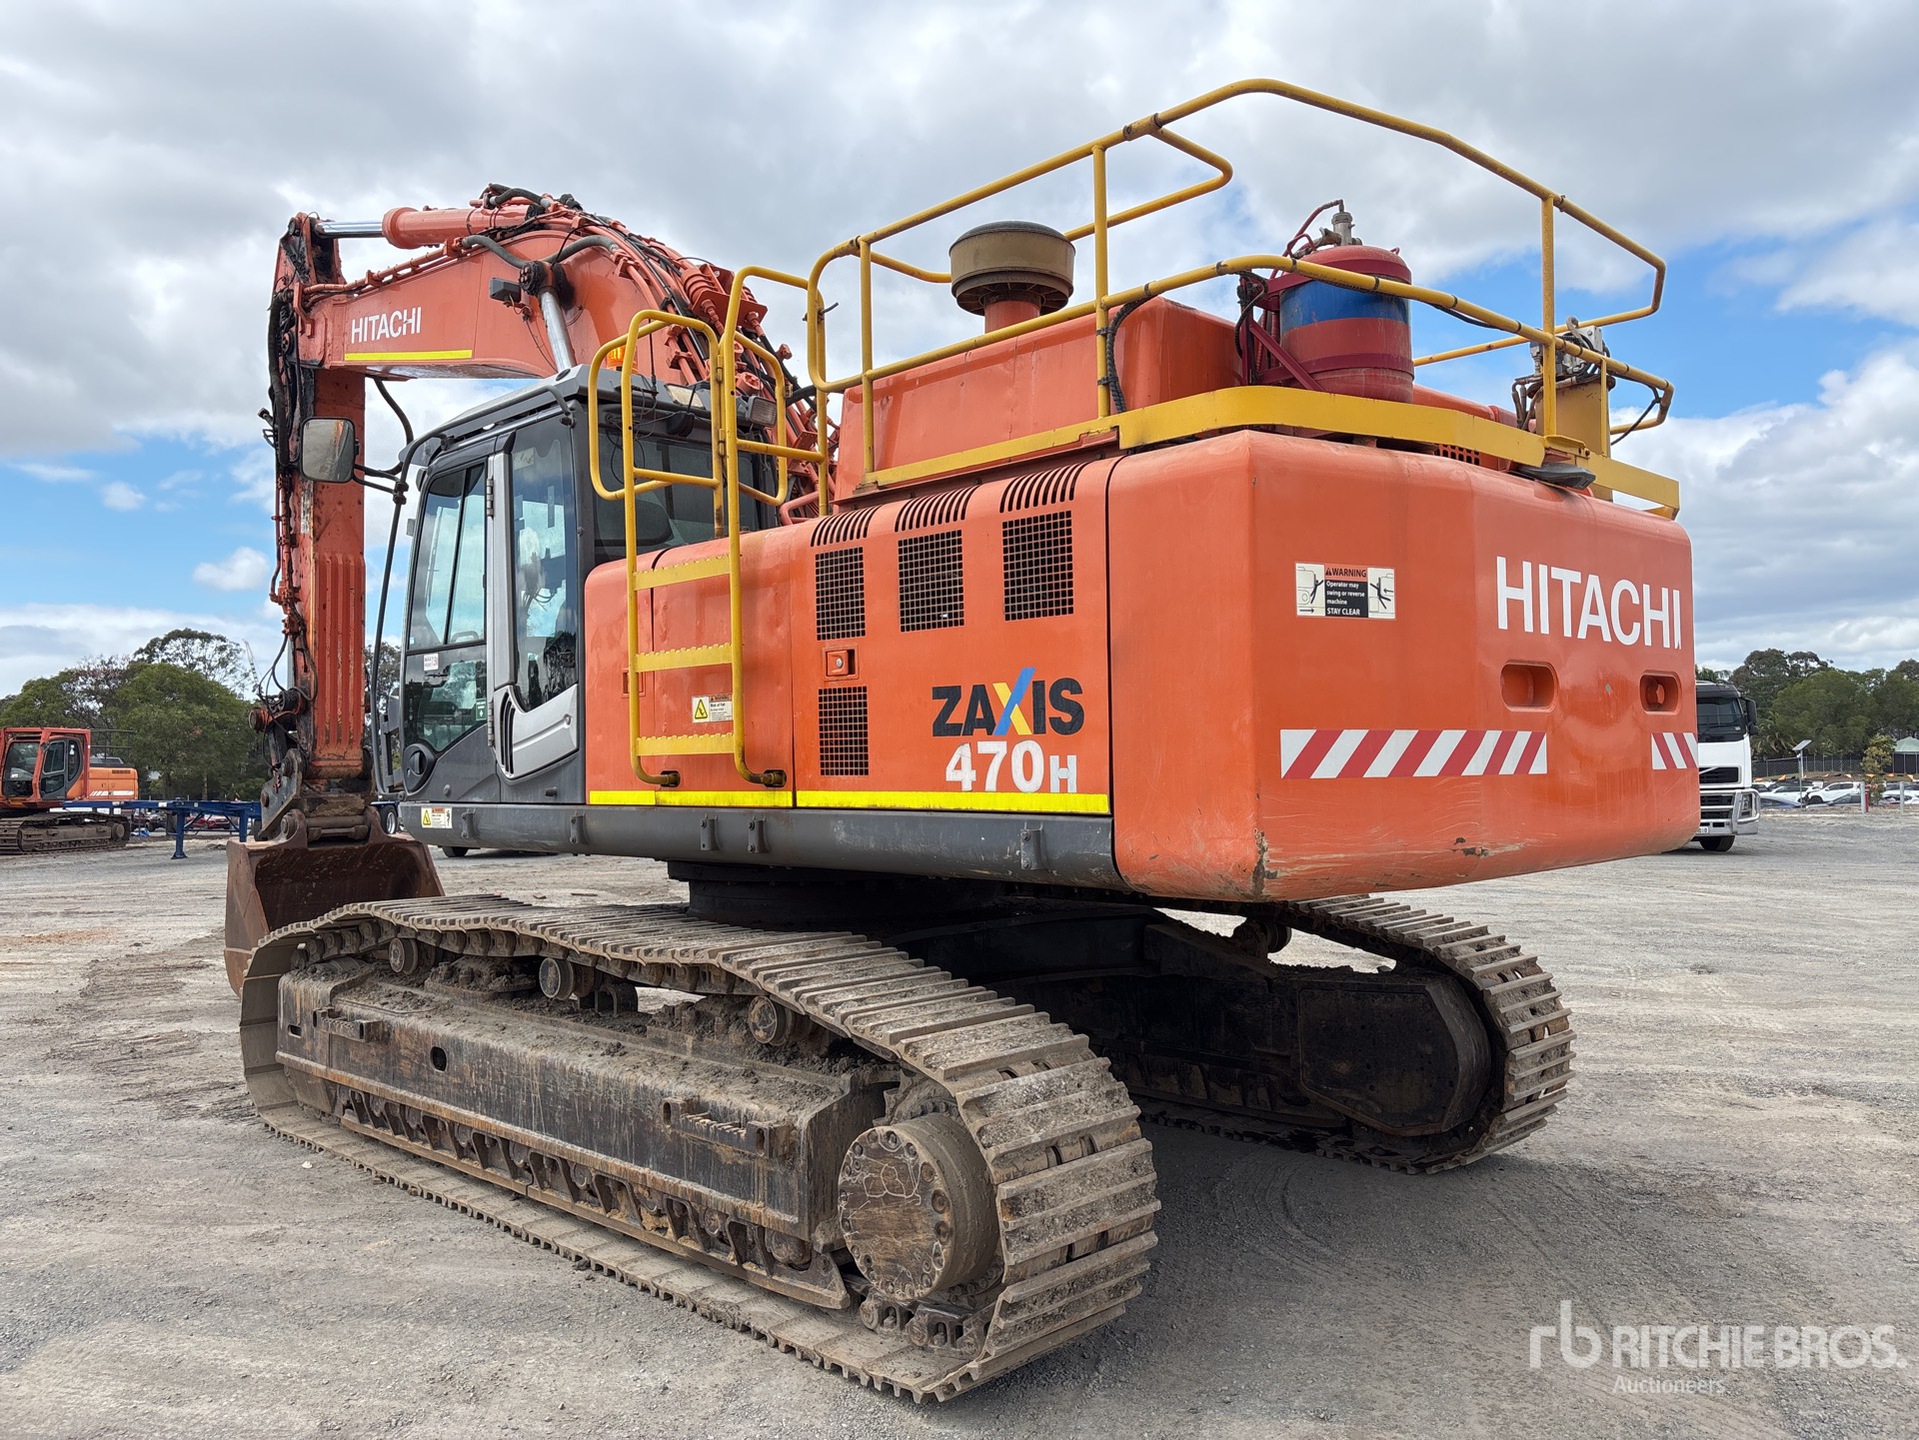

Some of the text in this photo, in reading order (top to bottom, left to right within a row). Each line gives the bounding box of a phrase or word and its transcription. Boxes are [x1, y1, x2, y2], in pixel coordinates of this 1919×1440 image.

[351, 306, 422, 344] HITACHI
[1326, 580, 1348, 588] Operator
[1332, 567, 1367, 578] WARNING
[1326, 590, 1341, 598] swing
[1496, 555, 1682, 650] HITACHI
[932, 667, 1085, 737] ZAXIS
